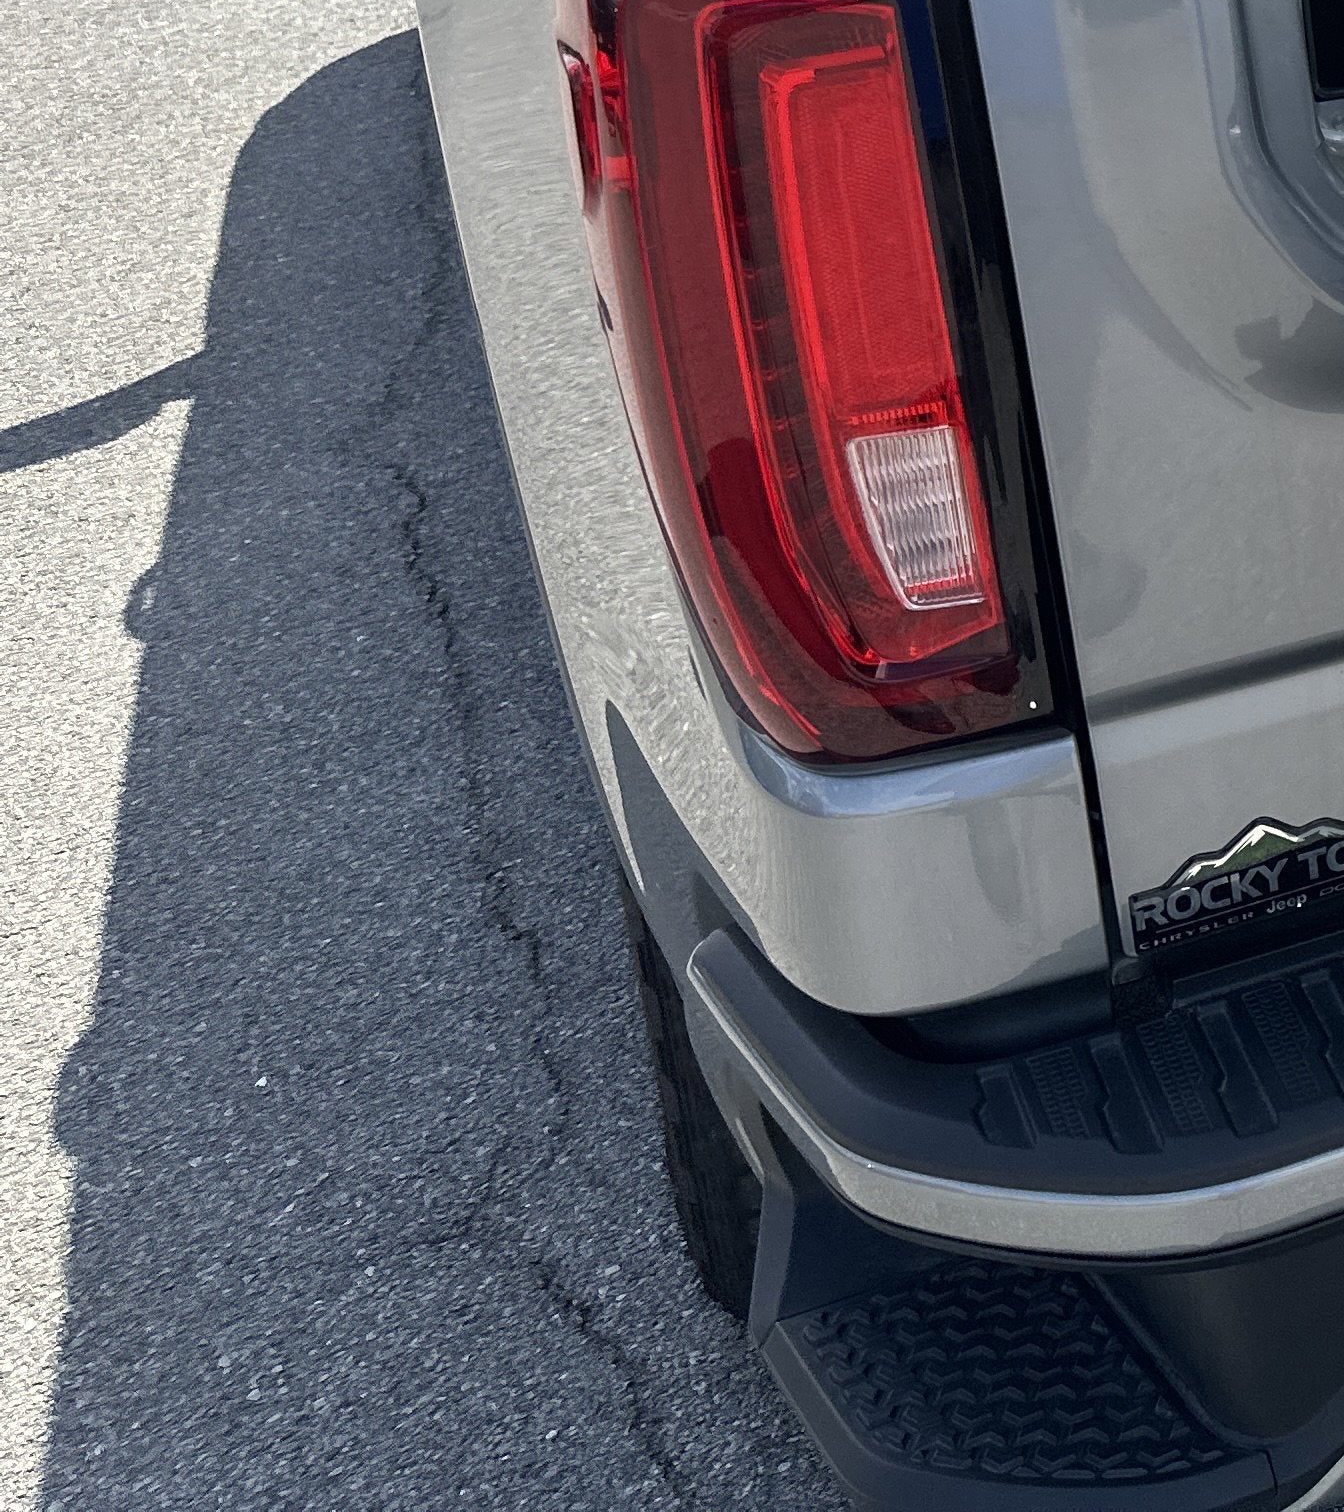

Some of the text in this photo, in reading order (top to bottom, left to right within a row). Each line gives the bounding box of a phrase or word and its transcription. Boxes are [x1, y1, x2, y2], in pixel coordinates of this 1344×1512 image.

[1132, 857, 1289, 931] ROCKY
[1138, 911, 1254, 950] CHRYSLER
[1266, 893, 1307, 914] Jeep
